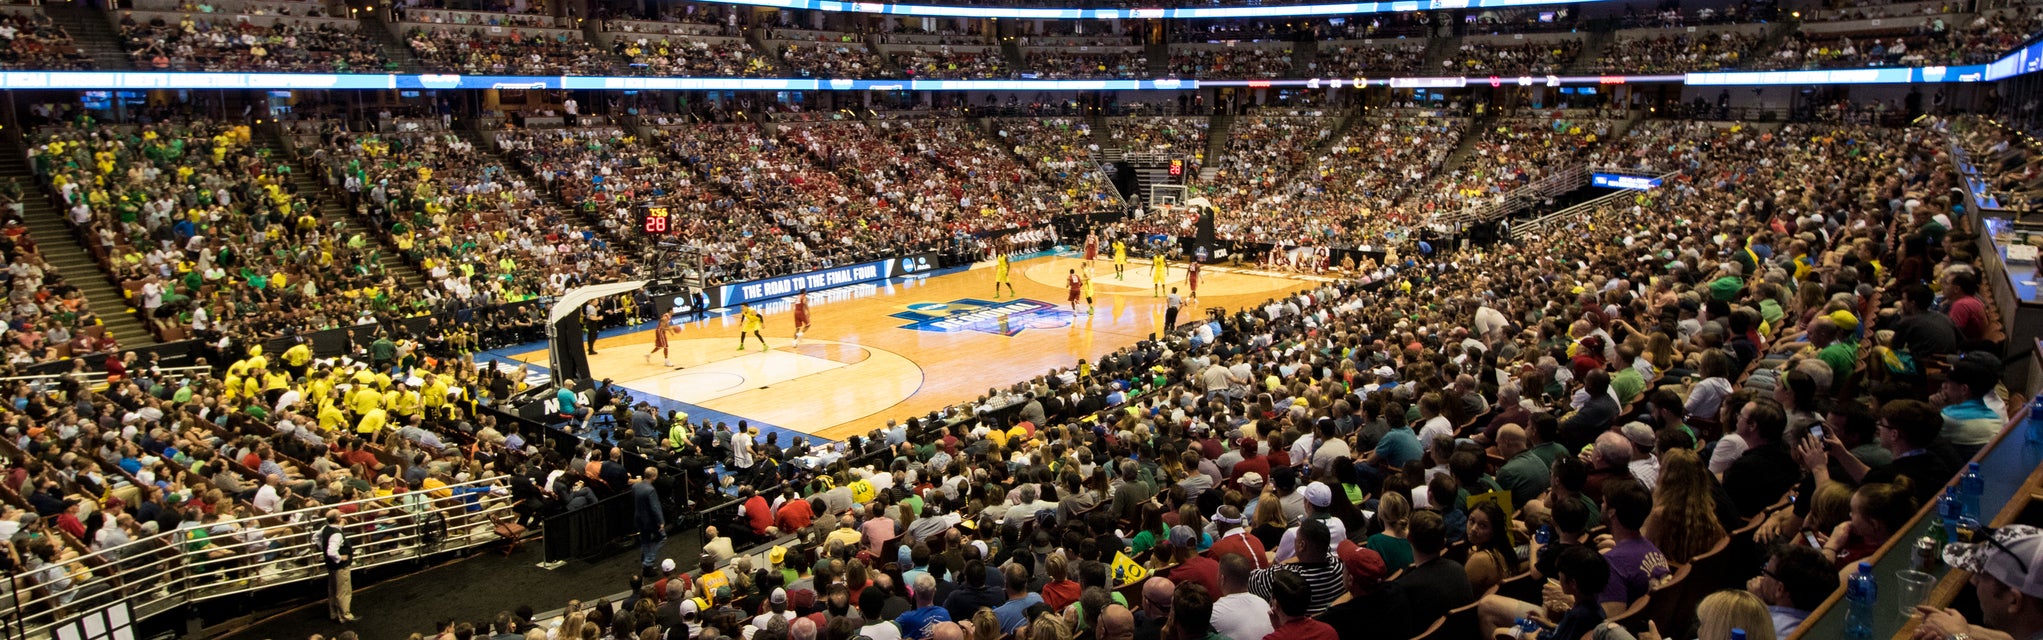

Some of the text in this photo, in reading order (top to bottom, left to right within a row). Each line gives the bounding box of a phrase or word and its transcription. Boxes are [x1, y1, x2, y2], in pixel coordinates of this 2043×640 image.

[646, 216, 666, 232] 28
[742, 265, 878, 300] THE ROAD TO THE FINAL FOUR
[544, 391, 590, 415] NA
